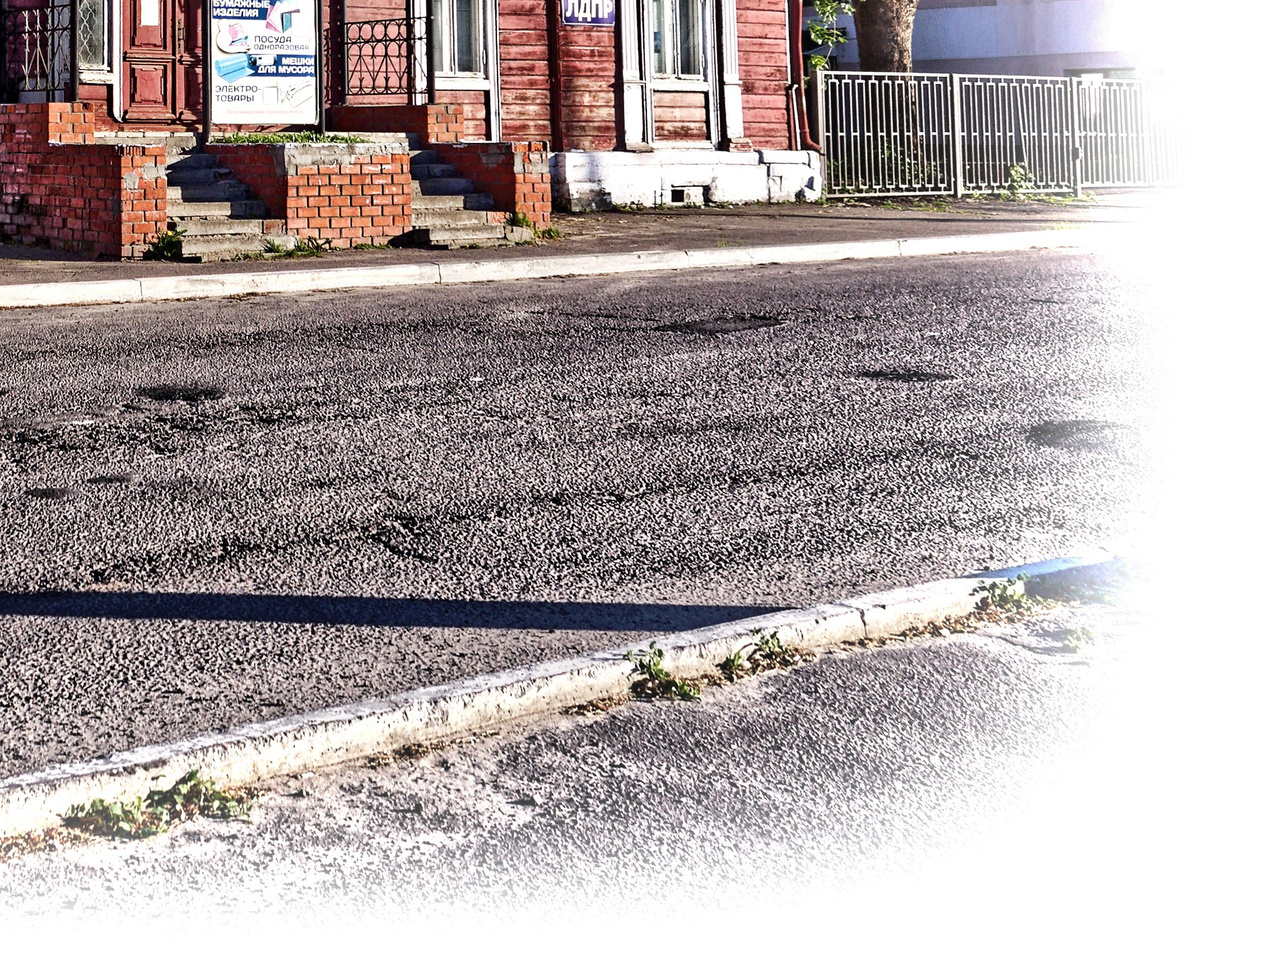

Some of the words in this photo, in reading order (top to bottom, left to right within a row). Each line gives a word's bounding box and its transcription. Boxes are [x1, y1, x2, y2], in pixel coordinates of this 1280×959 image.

[213, 8, 259, 18] ИЗДЕЛИЯ
[254, 35, 292, 43] ПОСУДА
[282, 57, 315, 66] МЕШКИ
[258, 65, 277, 74] ДЛЯ
[278, 65, 315, 74] МУСОРА
[215, 85, 261, 93] ЭЛЕКТРО-
[215, 94, 255, 102] ТОВАРЫ
